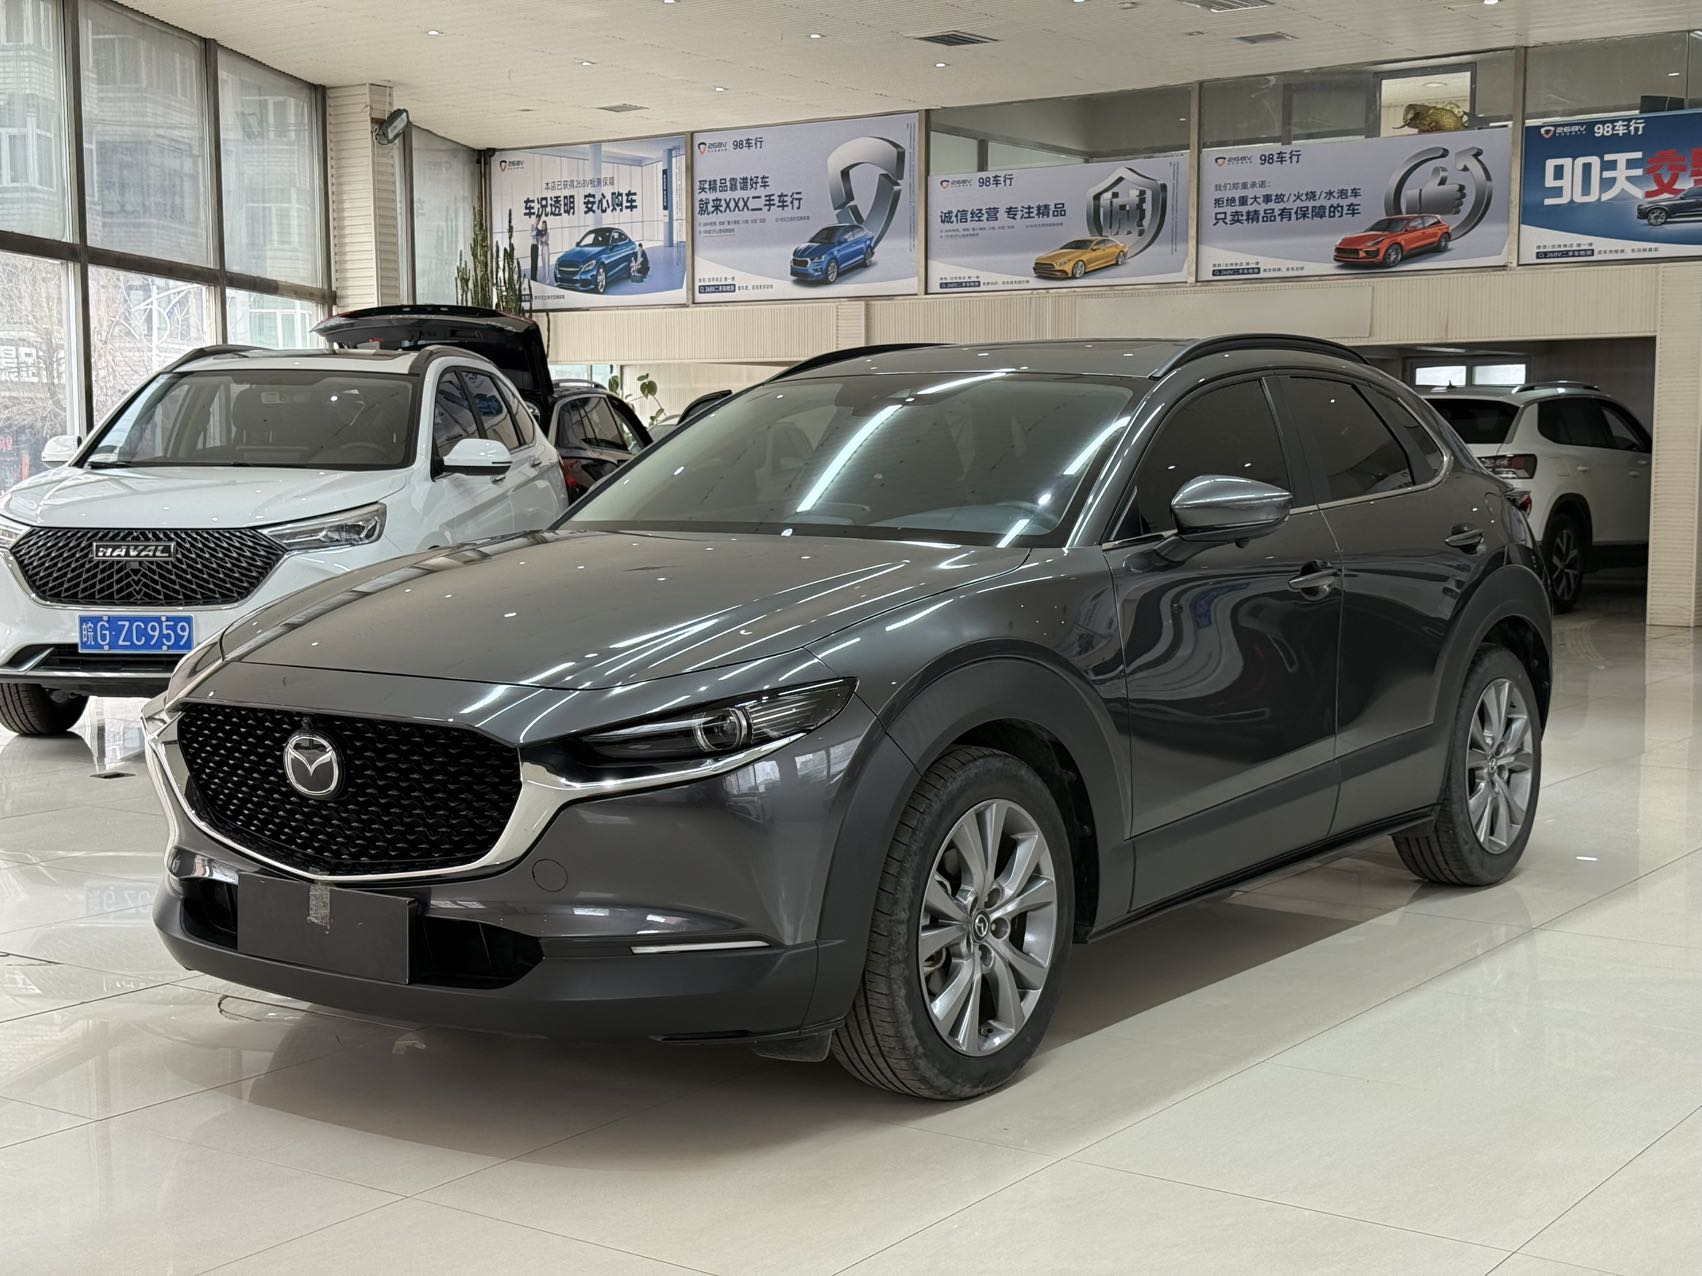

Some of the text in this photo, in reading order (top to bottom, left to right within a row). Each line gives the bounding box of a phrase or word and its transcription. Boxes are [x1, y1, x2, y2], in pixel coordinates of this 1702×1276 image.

[1593, 119, 1646, 137] 98车行
[732, 136, 764, 150] 98车行
[1259, 149, 1302, 166] 98车行
[697, 174, 771, 194] 买精品靠谱好车
[977, 173, 1014, 188] 98车行
[523, 194, 576, 219] 车况透明
[583, 189, 638, 215] 安心购车
[696, 191, 803, 216] 就来XXX二手车行
[1212, 187, 1362, 209] 拒绝重大事故/火烧/水泡车
[939, 202, 1067, 225] 诚信经营 专注精品
[1212, 202, 1362, 226] 只卖精品有保障的车
[97, 545, 169, 557] HAVAL
